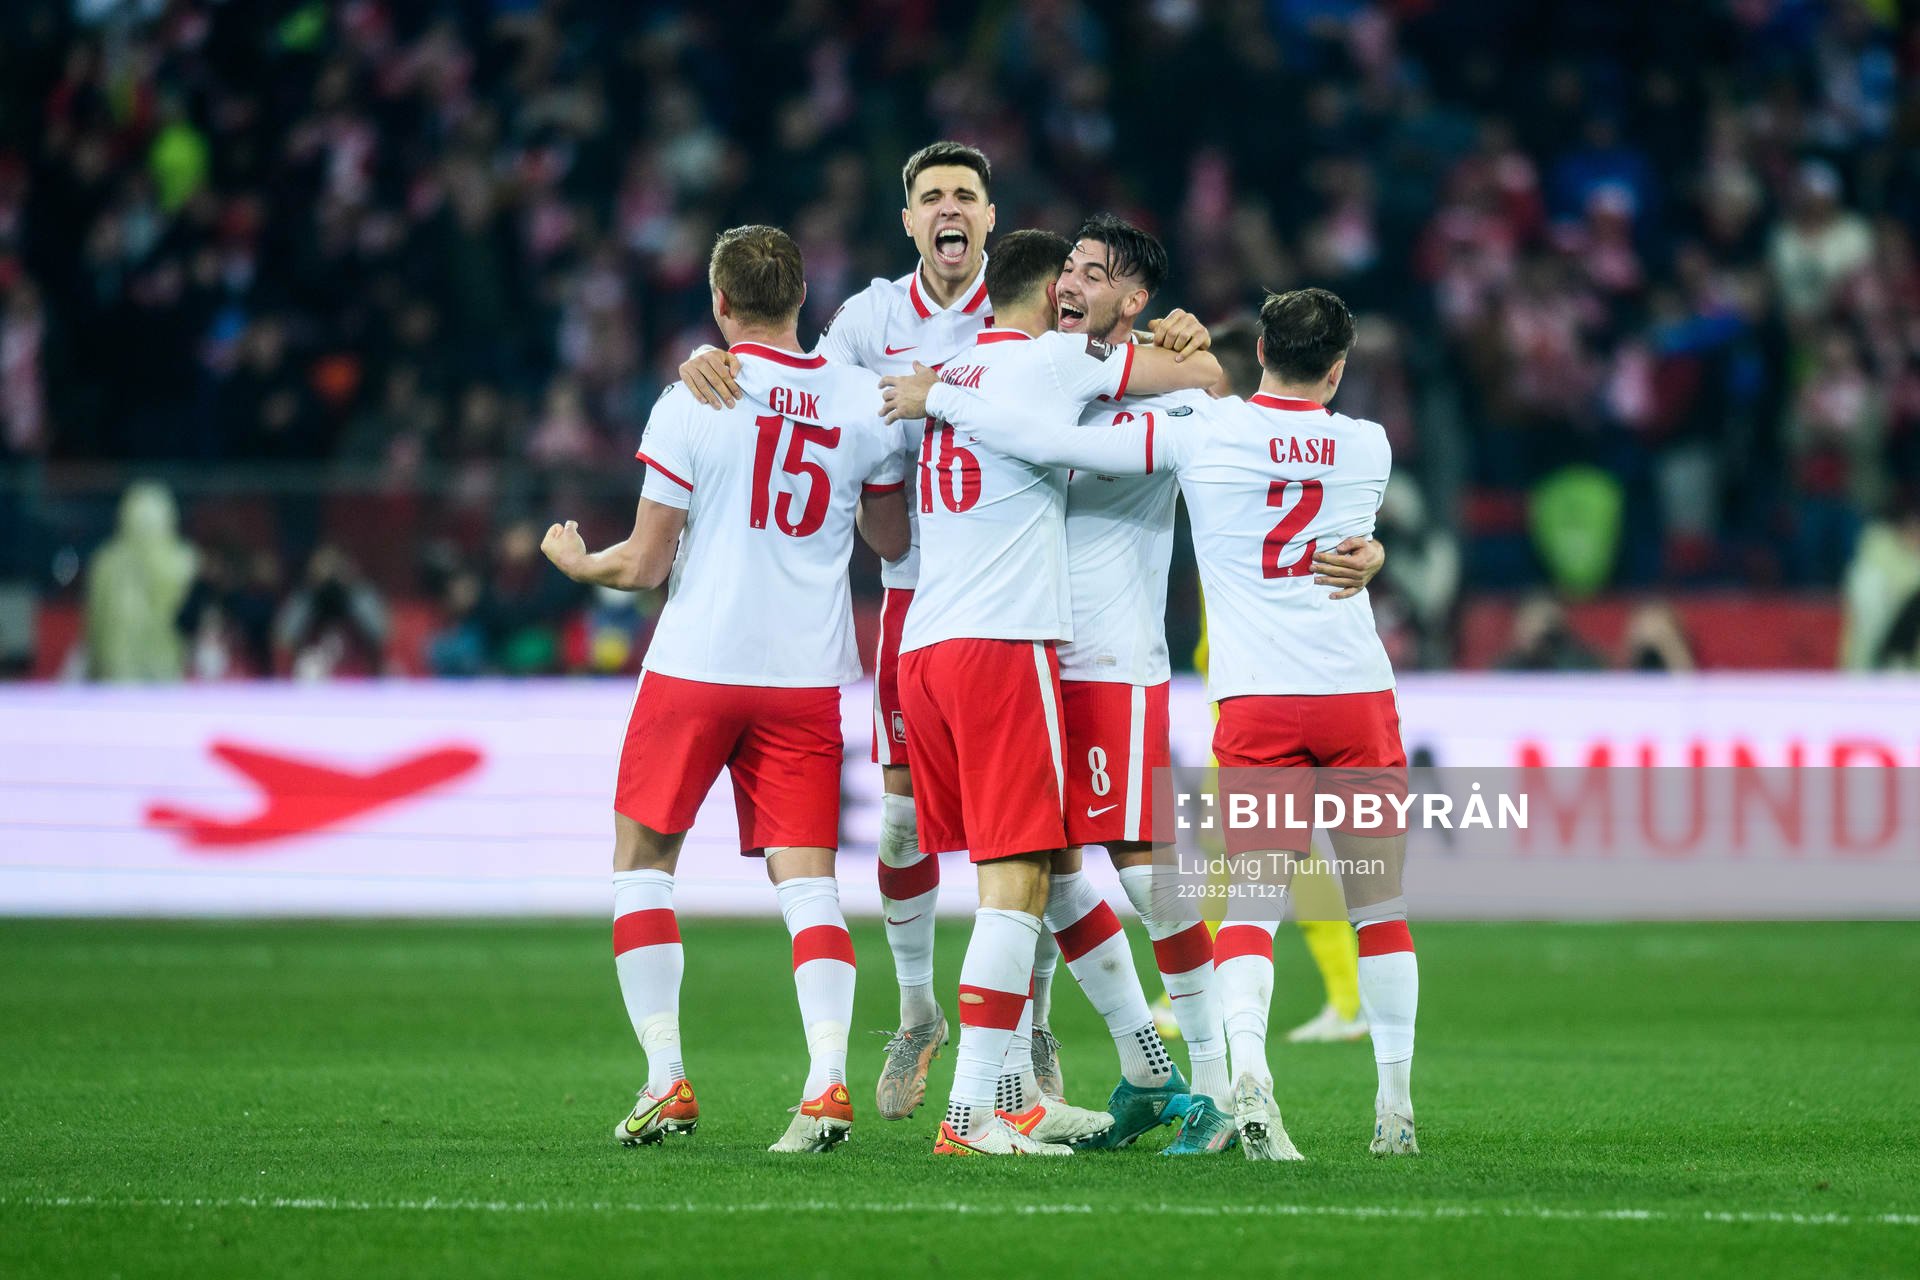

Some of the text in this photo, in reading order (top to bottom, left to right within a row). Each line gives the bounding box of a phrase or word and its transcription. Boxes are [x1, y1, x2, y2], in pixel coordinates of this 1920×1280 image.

[769, 386, 820, 420] GLIK
[749, 413, 841, 538] 15
[917, 416, 982, 513] 16
[1269, 436, 1336, 466] CASH
[1262, 480, 1324, 579] 2
[1087, 746, 1111, 796] 8
